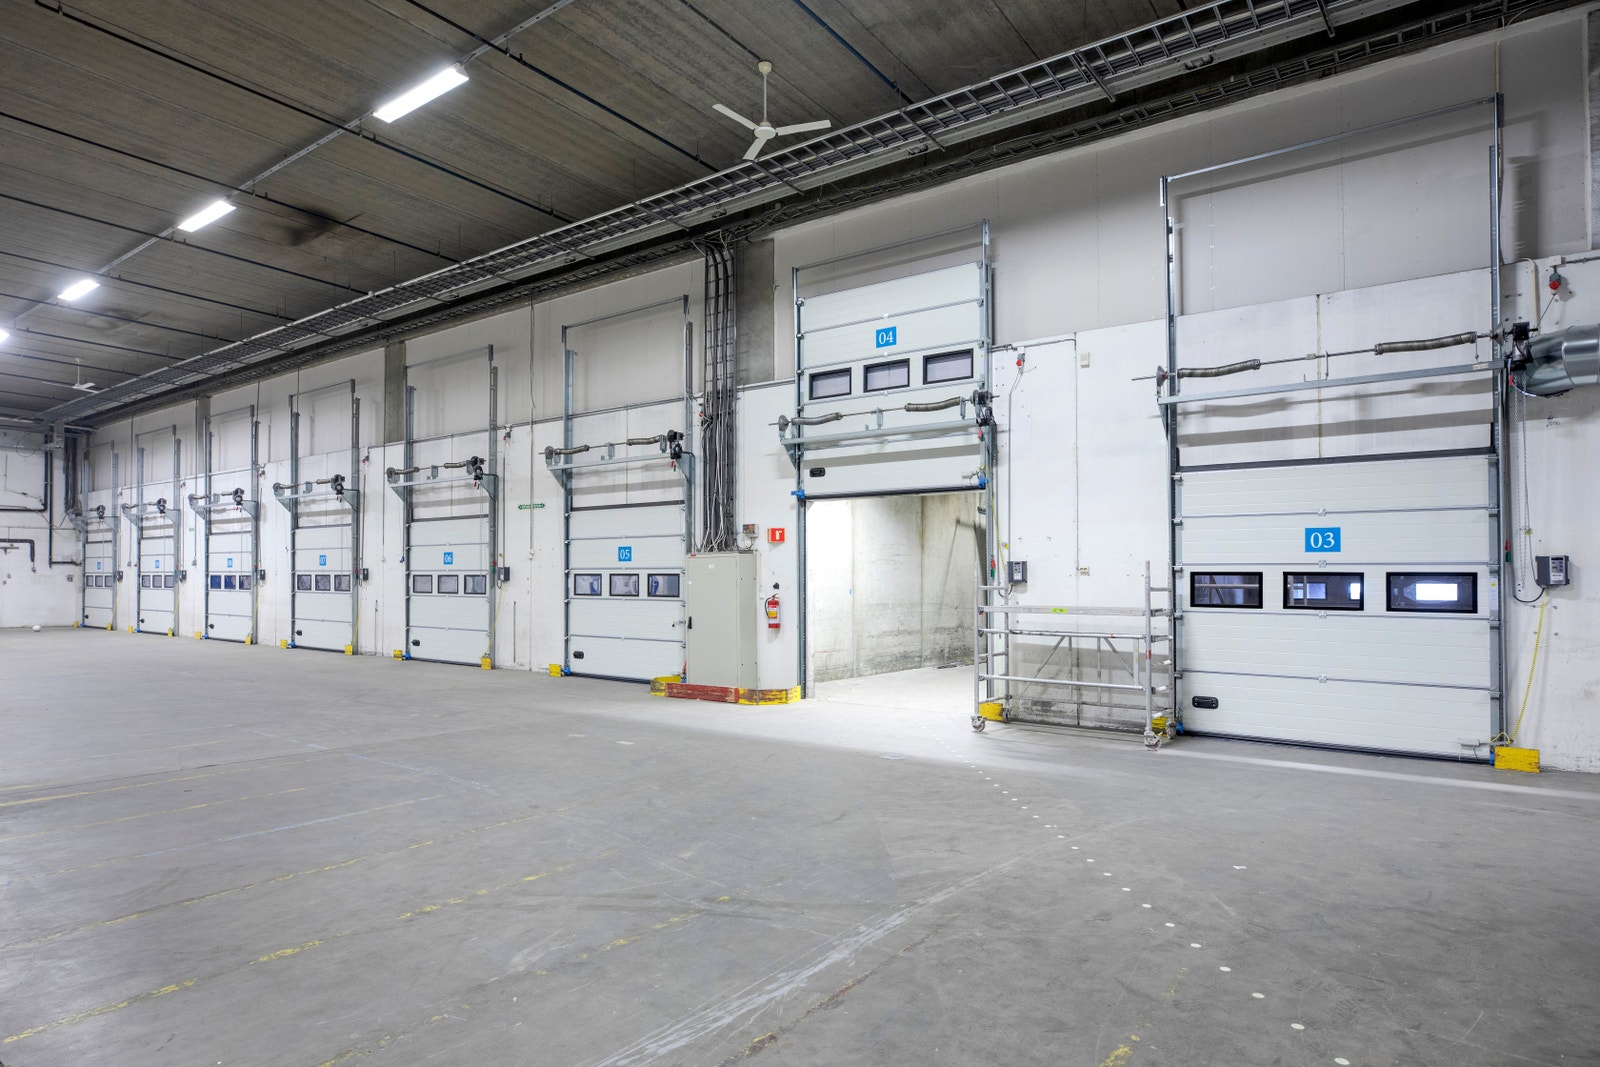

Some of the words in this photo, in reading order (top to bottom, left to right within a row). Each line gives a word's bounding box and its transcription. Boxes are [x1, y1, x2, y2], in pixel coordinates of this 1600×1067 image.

[878, 331, 894, 345] 04
[1310, 532, 1335, 548] 03
[620, 549, 630, 560] 05
